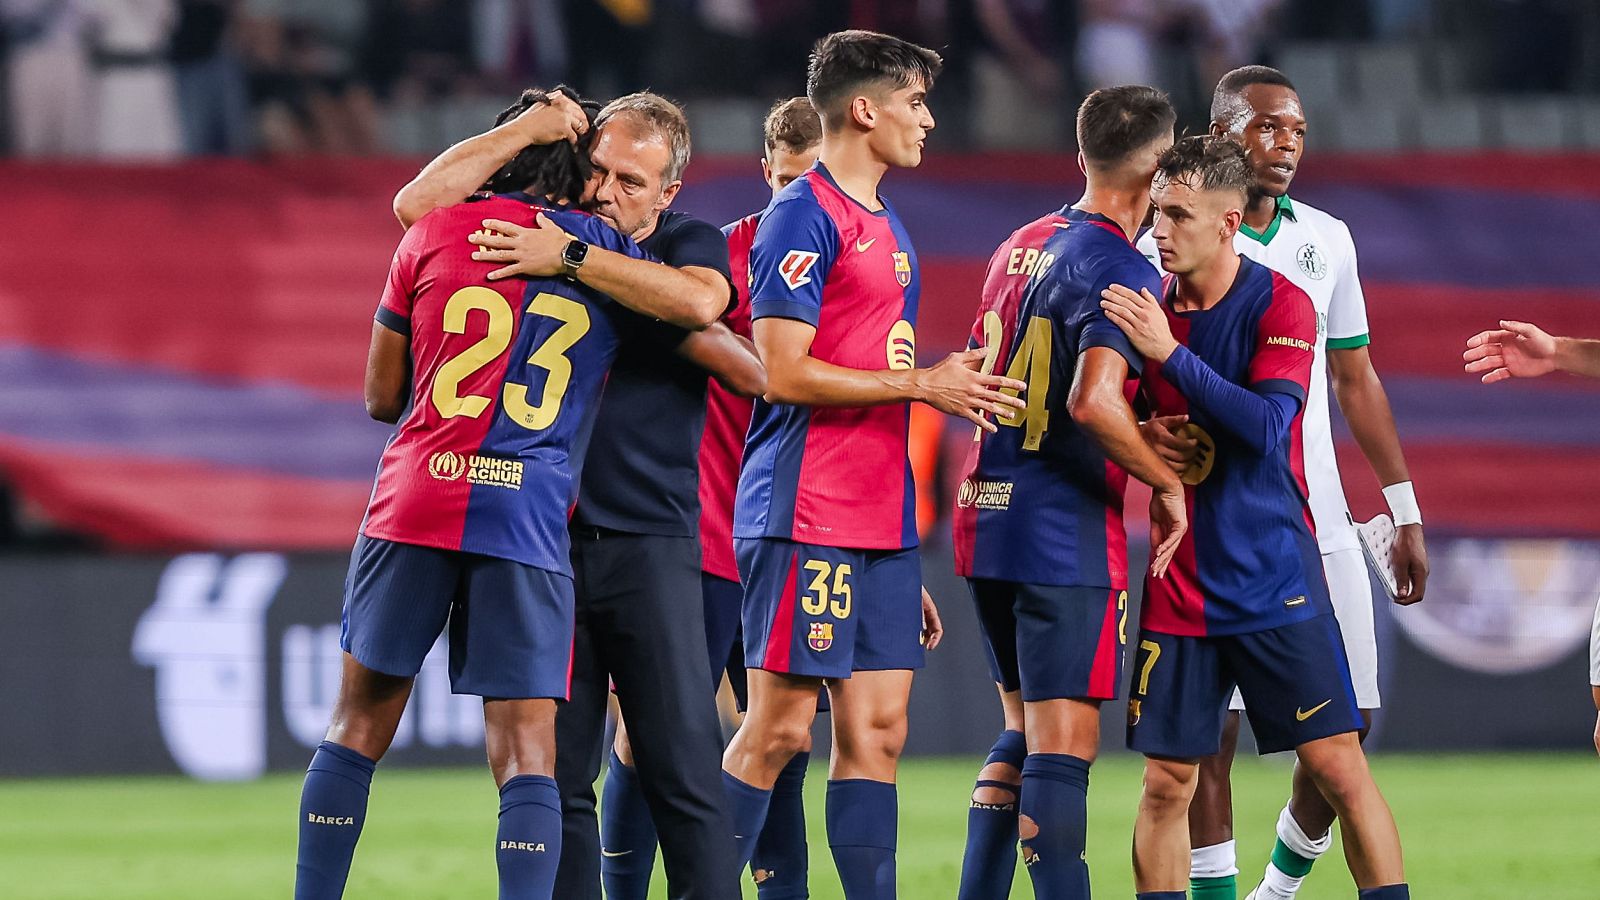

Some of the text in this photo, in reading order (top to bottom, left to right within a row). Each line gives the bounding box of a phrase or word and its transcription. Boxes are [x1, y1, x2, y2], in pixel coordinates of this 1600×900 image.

[1006, 247, 1055, 280] ERIC
[1266, 336, 1310, 352] AMBILIGHT
[432, 286, 591, 431] 23
[468, 455, 524, 473] UNHCR
[466, 467, 522, 485] ACNUR
[979, 481, 1014, 494] UNHCR
[975, 493, 1010, 505] ACNUR
[801, 559, 852, 619] 35
[1138, 640, 1161, 695] 7
[308, 812, 354, 826] BARÇA
[500, 840, 546, 852] BARÇA
